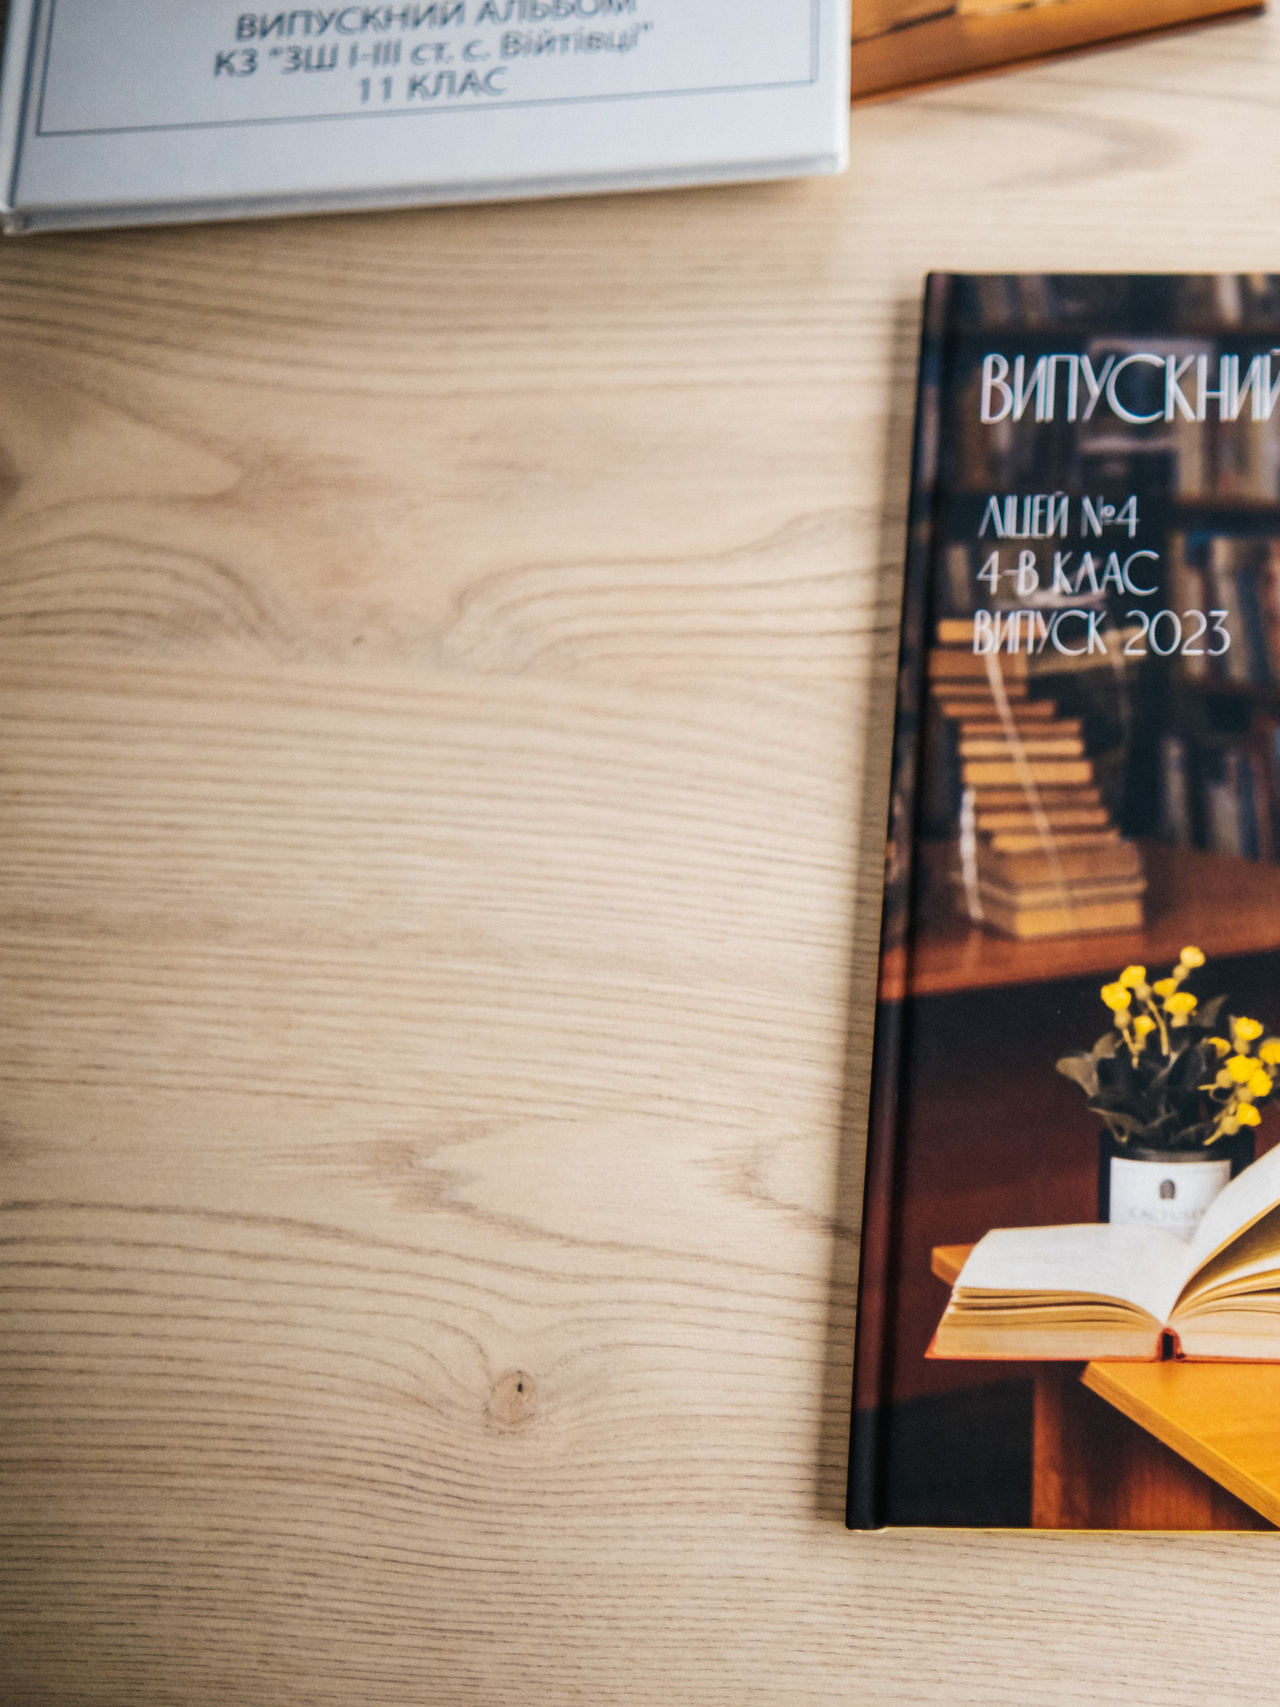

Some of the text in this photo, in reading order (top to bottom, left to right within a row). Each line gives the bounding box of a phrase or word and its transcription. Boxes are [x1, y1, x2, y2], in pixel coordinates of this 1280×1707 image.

[235, 0, 466, 41] ВИПУСКНИЙ
[410, 41, 453, 67] ст.
[462, 39, 491, 63] с.
[360, 66, 508, 102] 11 КЛАС
[1080, 494, 1141, 539] №4
[976, 549, 1160, 597] 4-В КЛАС
[972, 608, 1231, 657] ВИПУСК 2023
